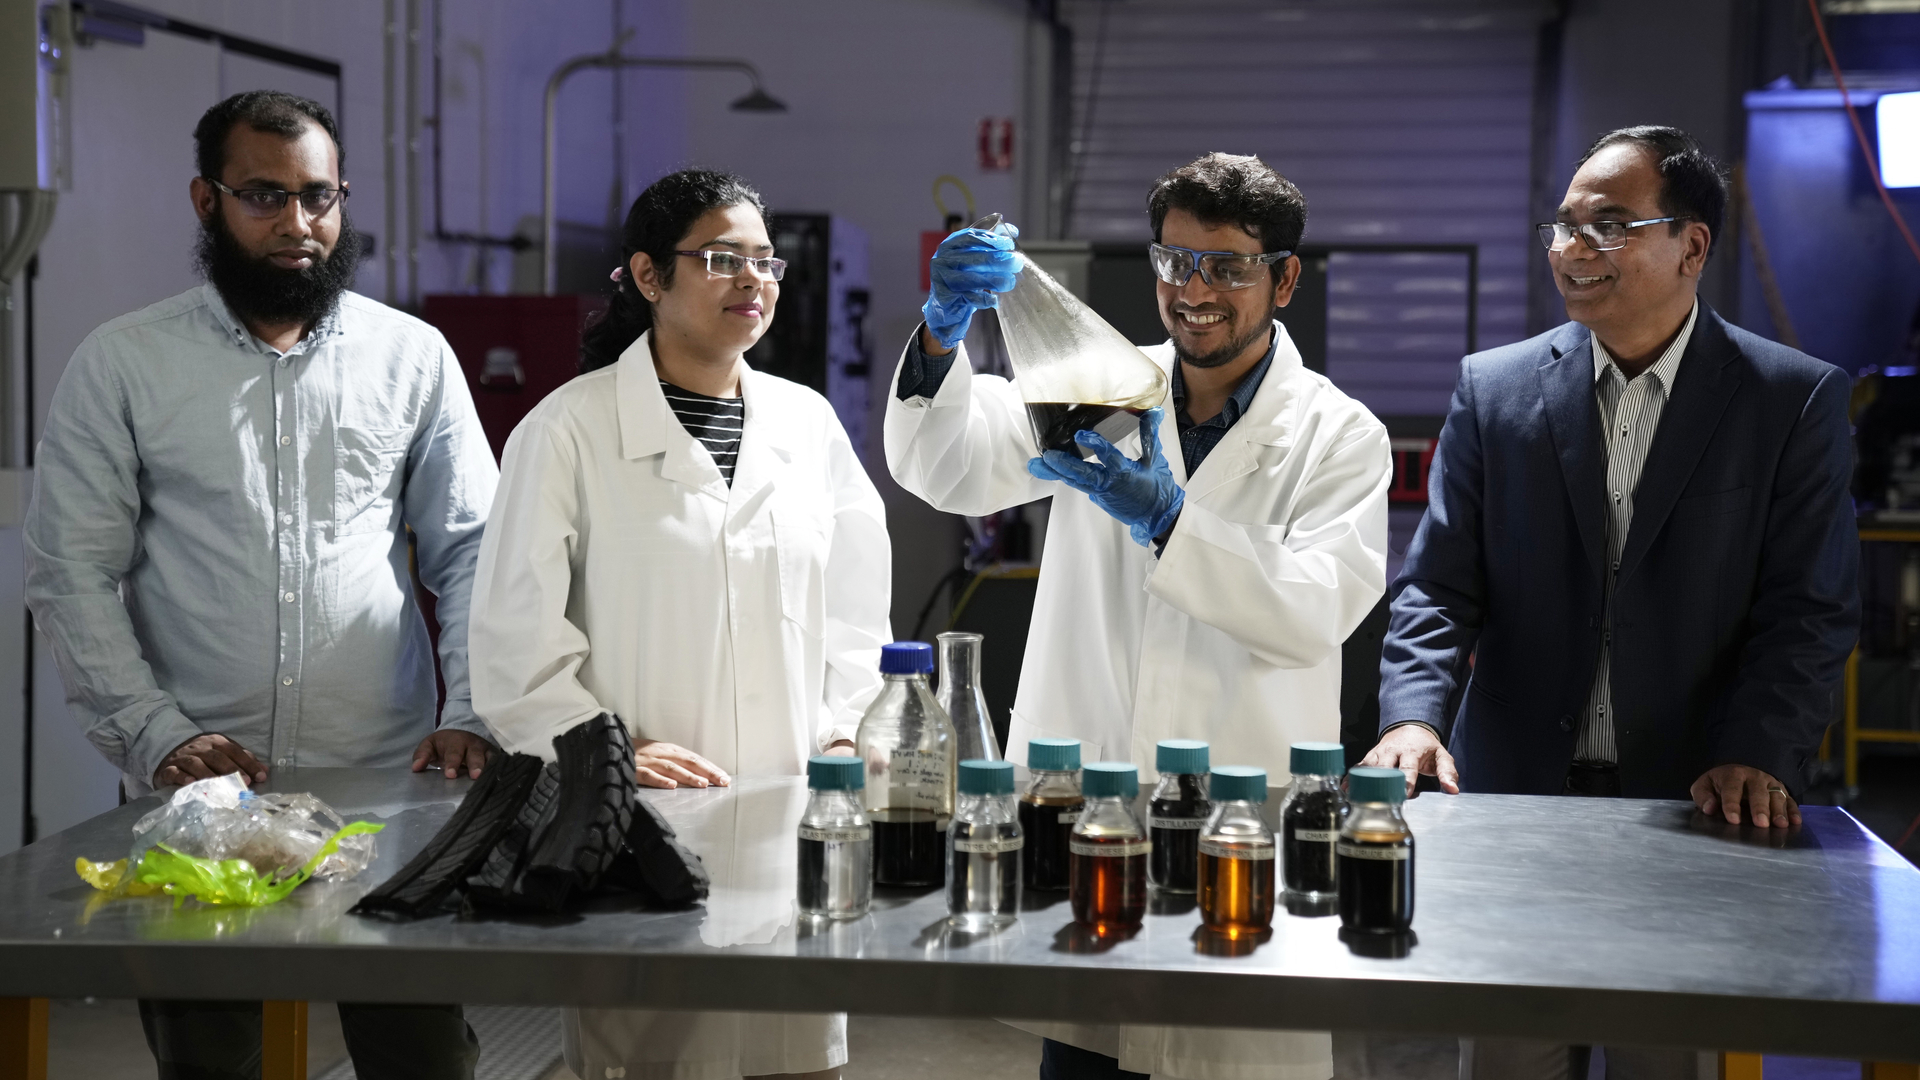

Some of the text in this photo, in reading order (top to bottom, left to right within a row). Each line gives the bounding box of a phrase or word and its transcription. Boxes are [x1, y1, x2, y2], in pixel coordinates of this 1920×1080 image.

[1155, 819, 1205, 828] DISTILLATION
[802, 830, 862, 841] PLASTIC DIESEL
[1304, 832, 1329, 841] CHAR
[963, 843, 984, 852] TYRE
